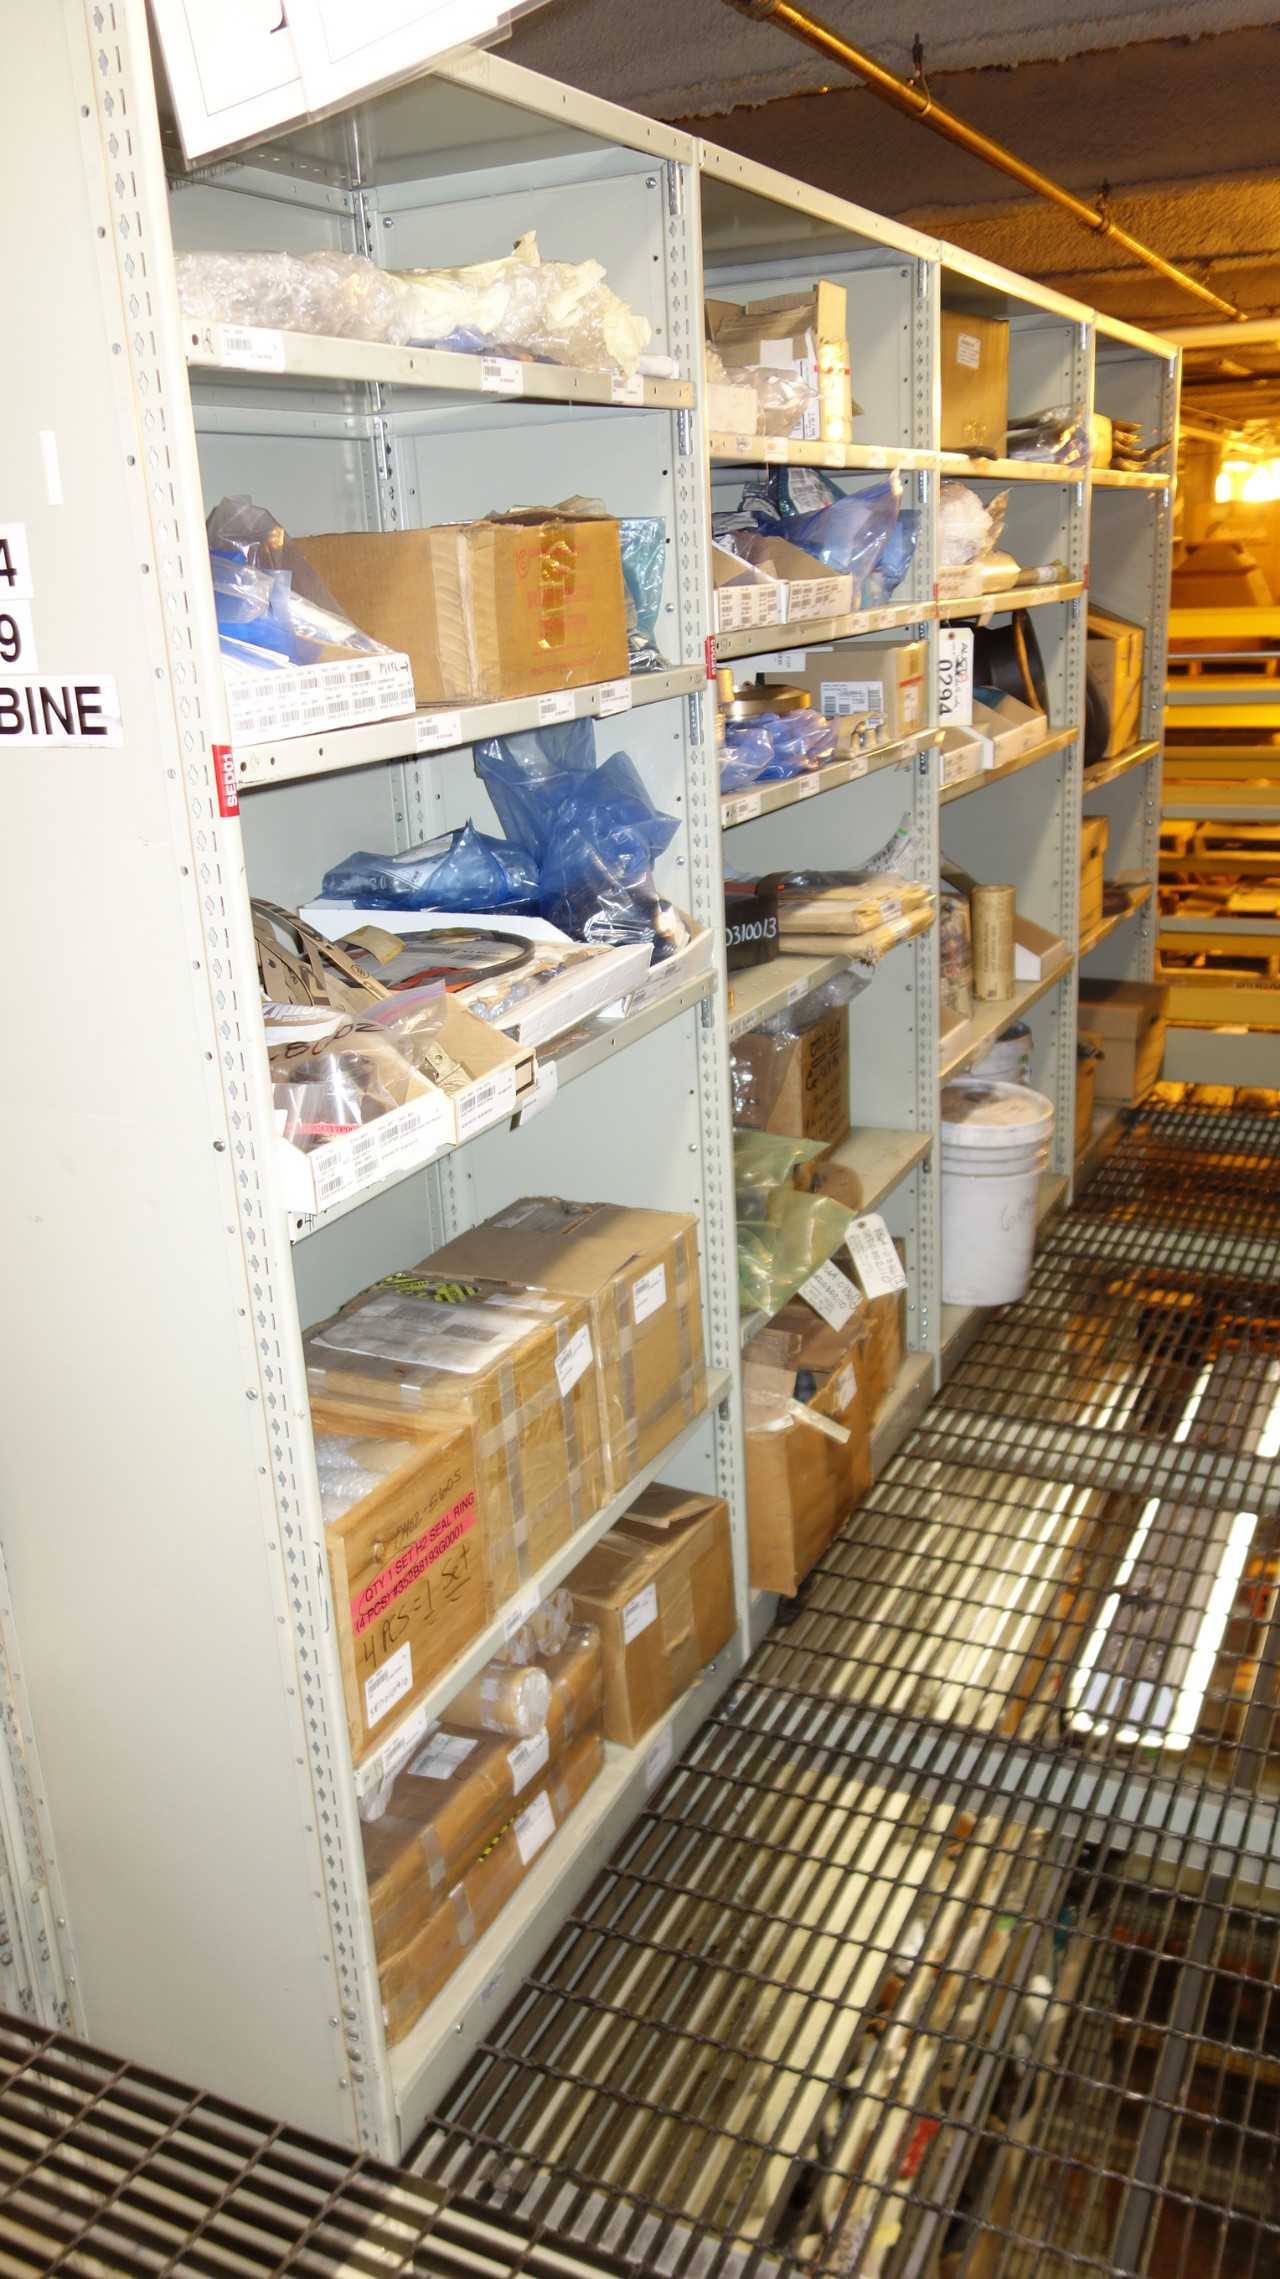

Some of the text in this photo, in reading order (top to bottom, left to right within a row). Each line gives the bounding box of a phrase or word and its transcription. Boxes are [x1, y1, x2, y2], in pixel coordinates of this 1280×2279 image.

[0, 686, 108, 735] BINE
[222, 752, 238, 807] SED01
[366, 1580, 384, 1601] QTY
[395, 1551, 413, 1574] SET
[430, 1516, 452, 1541] SEAL
[453, 1492, 475, 1518] RING
